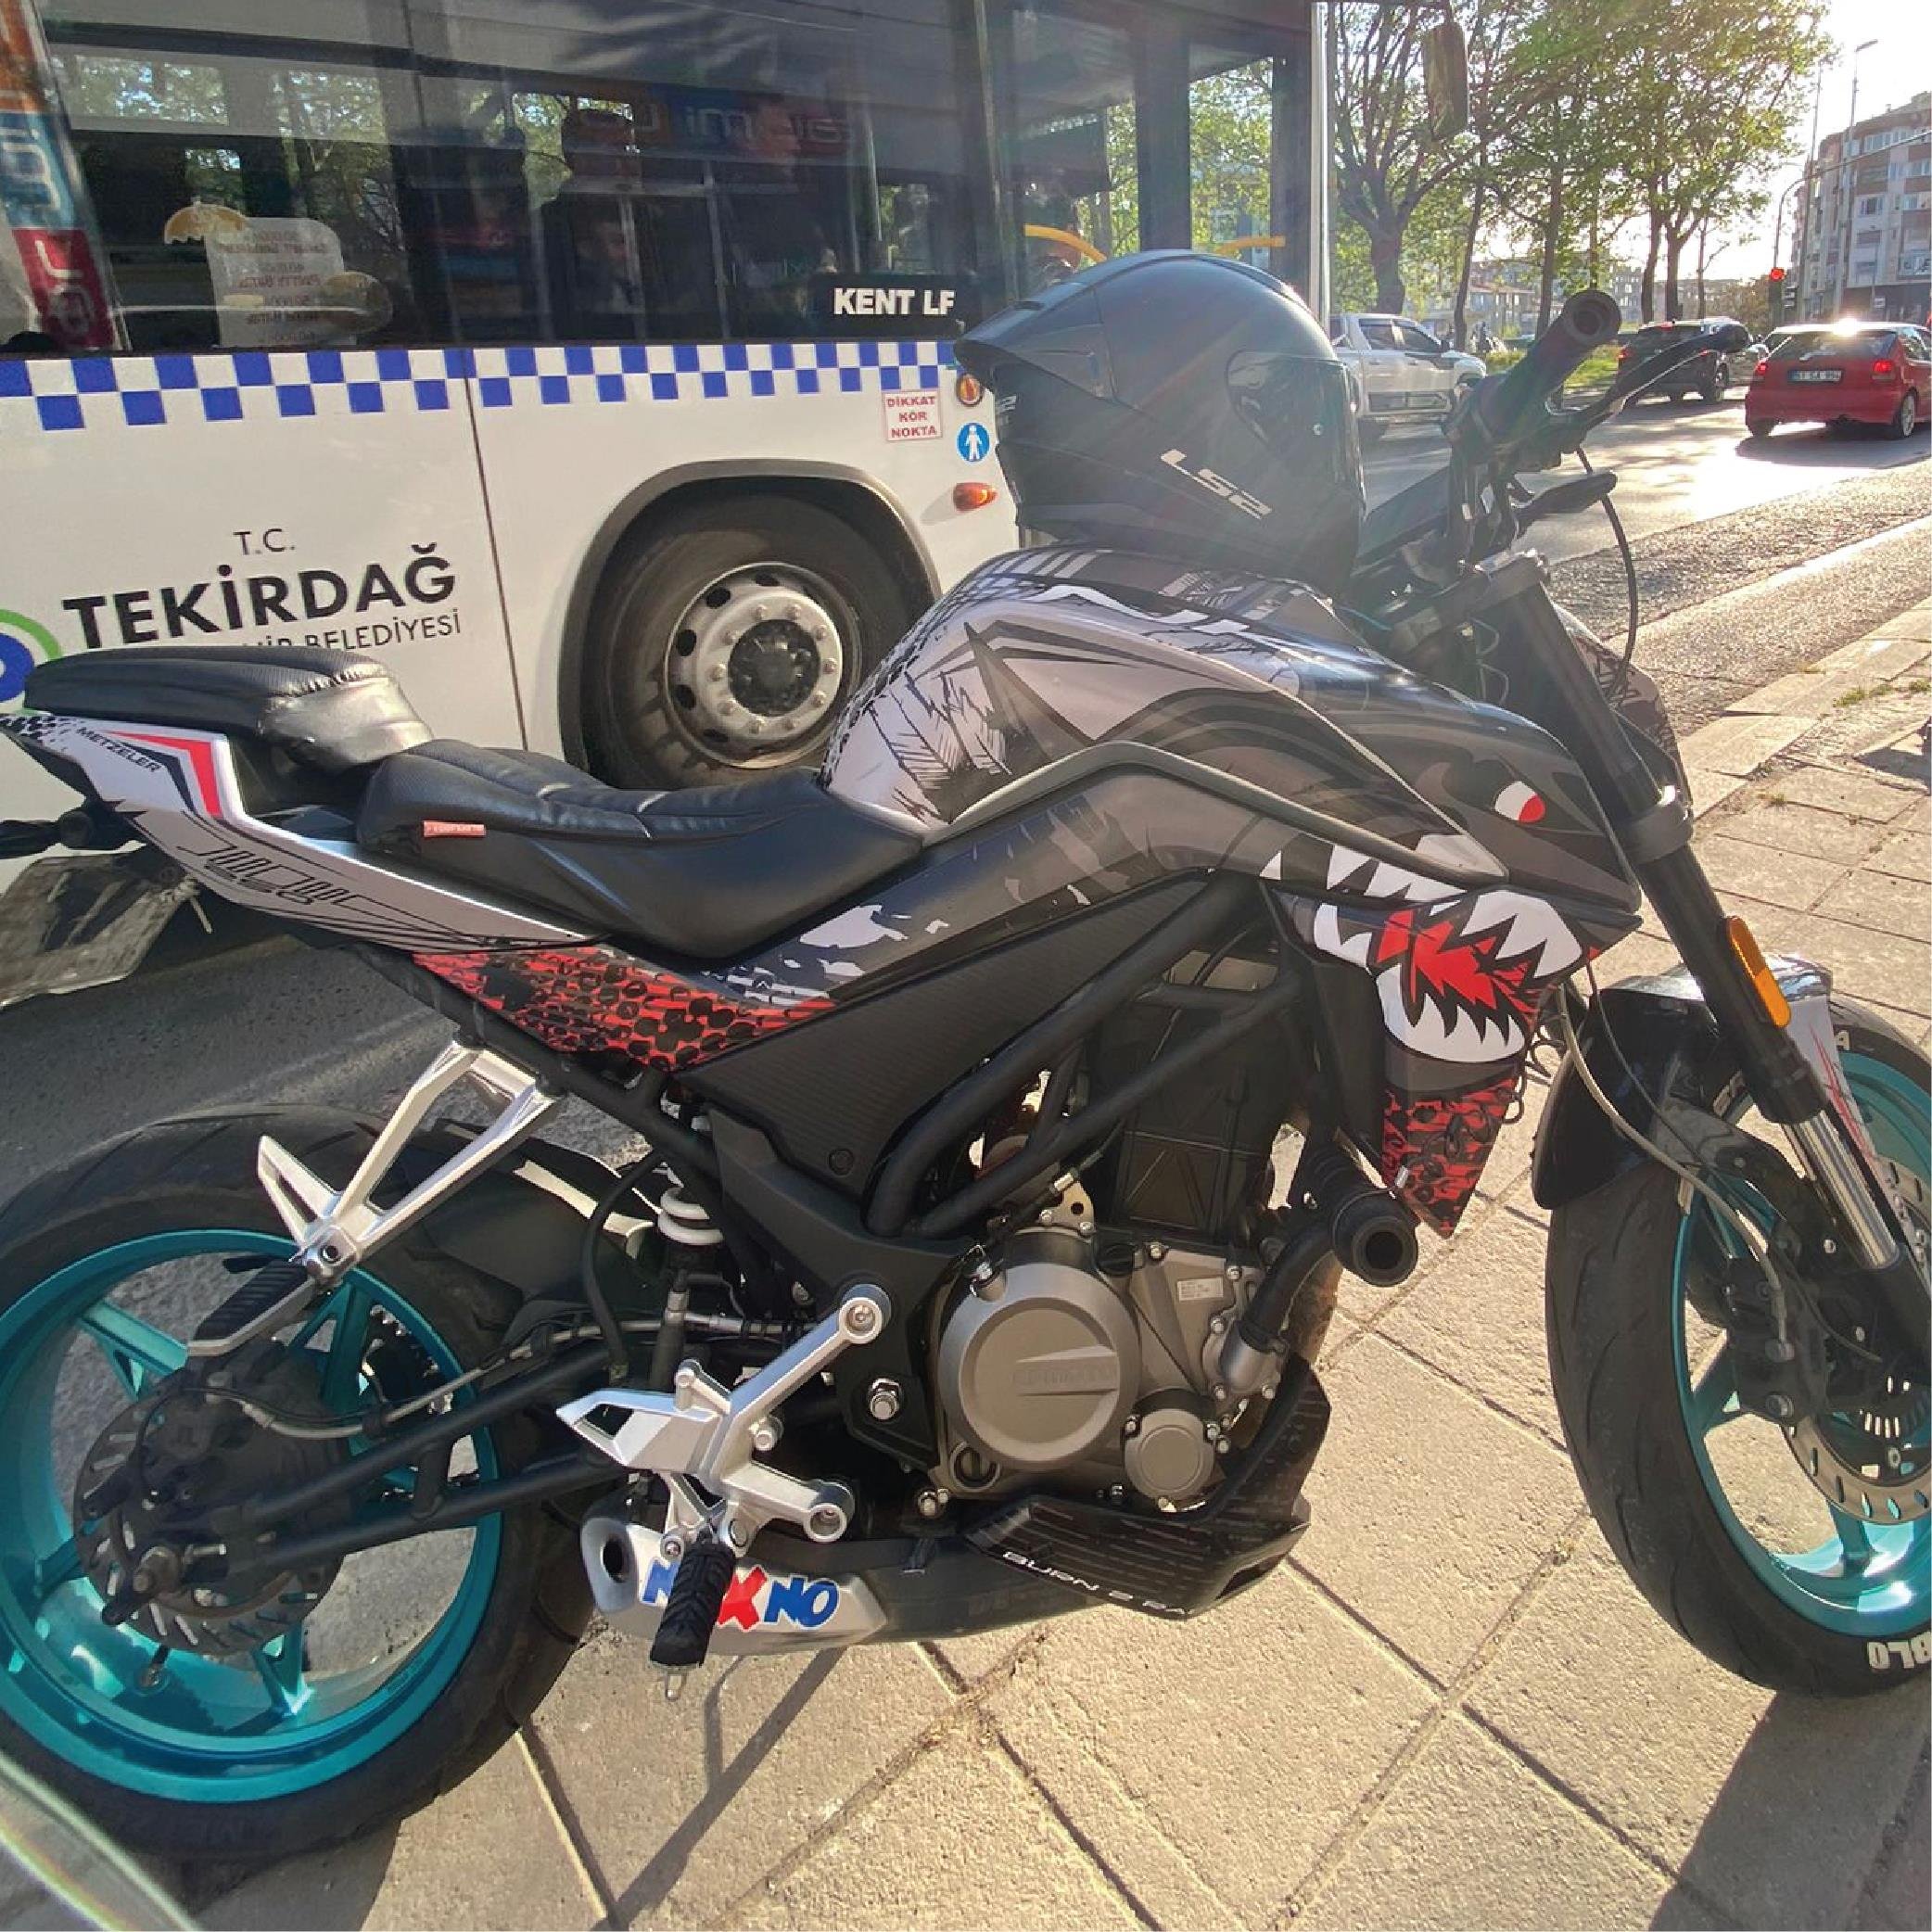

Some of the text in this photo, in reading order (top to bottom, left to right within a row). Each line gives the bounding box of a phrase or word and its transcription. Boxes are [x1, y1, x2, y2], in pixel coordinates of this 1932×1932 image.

[834, 287, 956, 315] KENT LF
[887, 396, 935, 407] DİKKAT
[898, 409, 928, 423] KÖR
[892, 426, 938, 438] NOKTA
[233, 527, 296, 555] T.C.
[62, 542, 456, 649] TEKİRDAĞ
[76, 727, 161, 772] METZELER
[1003, 1551, 1099, 1591] BURN
[641, 1560, 841, 1632] NXNO
